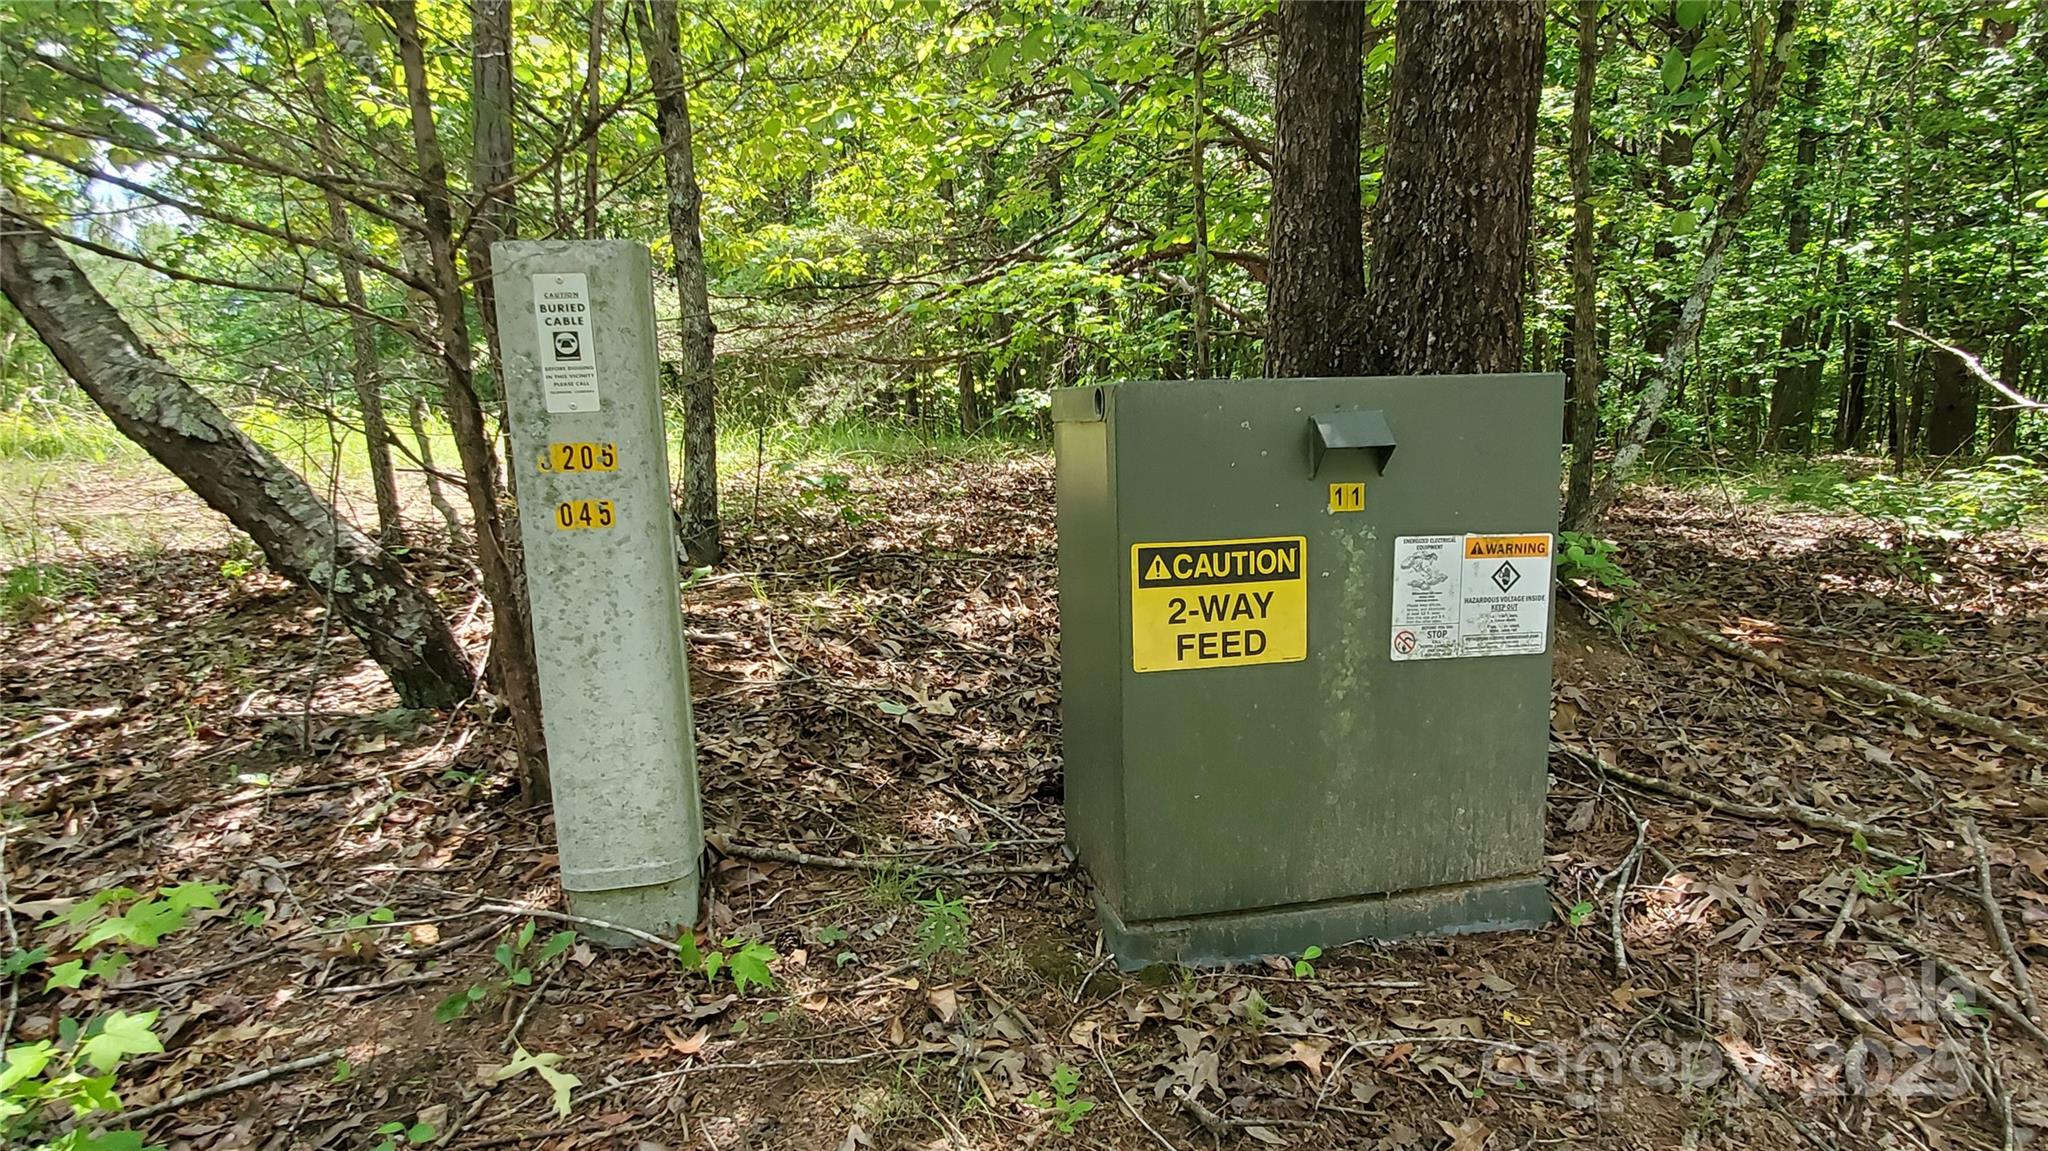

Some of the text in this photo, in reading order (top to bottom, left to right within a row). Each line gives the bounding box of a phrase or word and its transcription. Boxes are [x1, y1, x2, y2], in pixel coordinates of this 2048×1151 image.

[539, 303, 586, 313] BURIED
[545, 316, 585, 326] CABLE
[1335, 486, 1359, 507] 11
[560, 502, 611, 527] 045
[1486, 542, 1546, 555] WARNING
[1172, 548, 1296, 579] CAUTION
[1167, 591, 1274, 624] 2-WAY
[1464, 596, 1499, 604] HAZARDOUS
[1500, 595, 1525, 603] VOLTAGE
[1427, 630, 1448, 639] STOP
[1177, 629, 1267, 661] FEED
